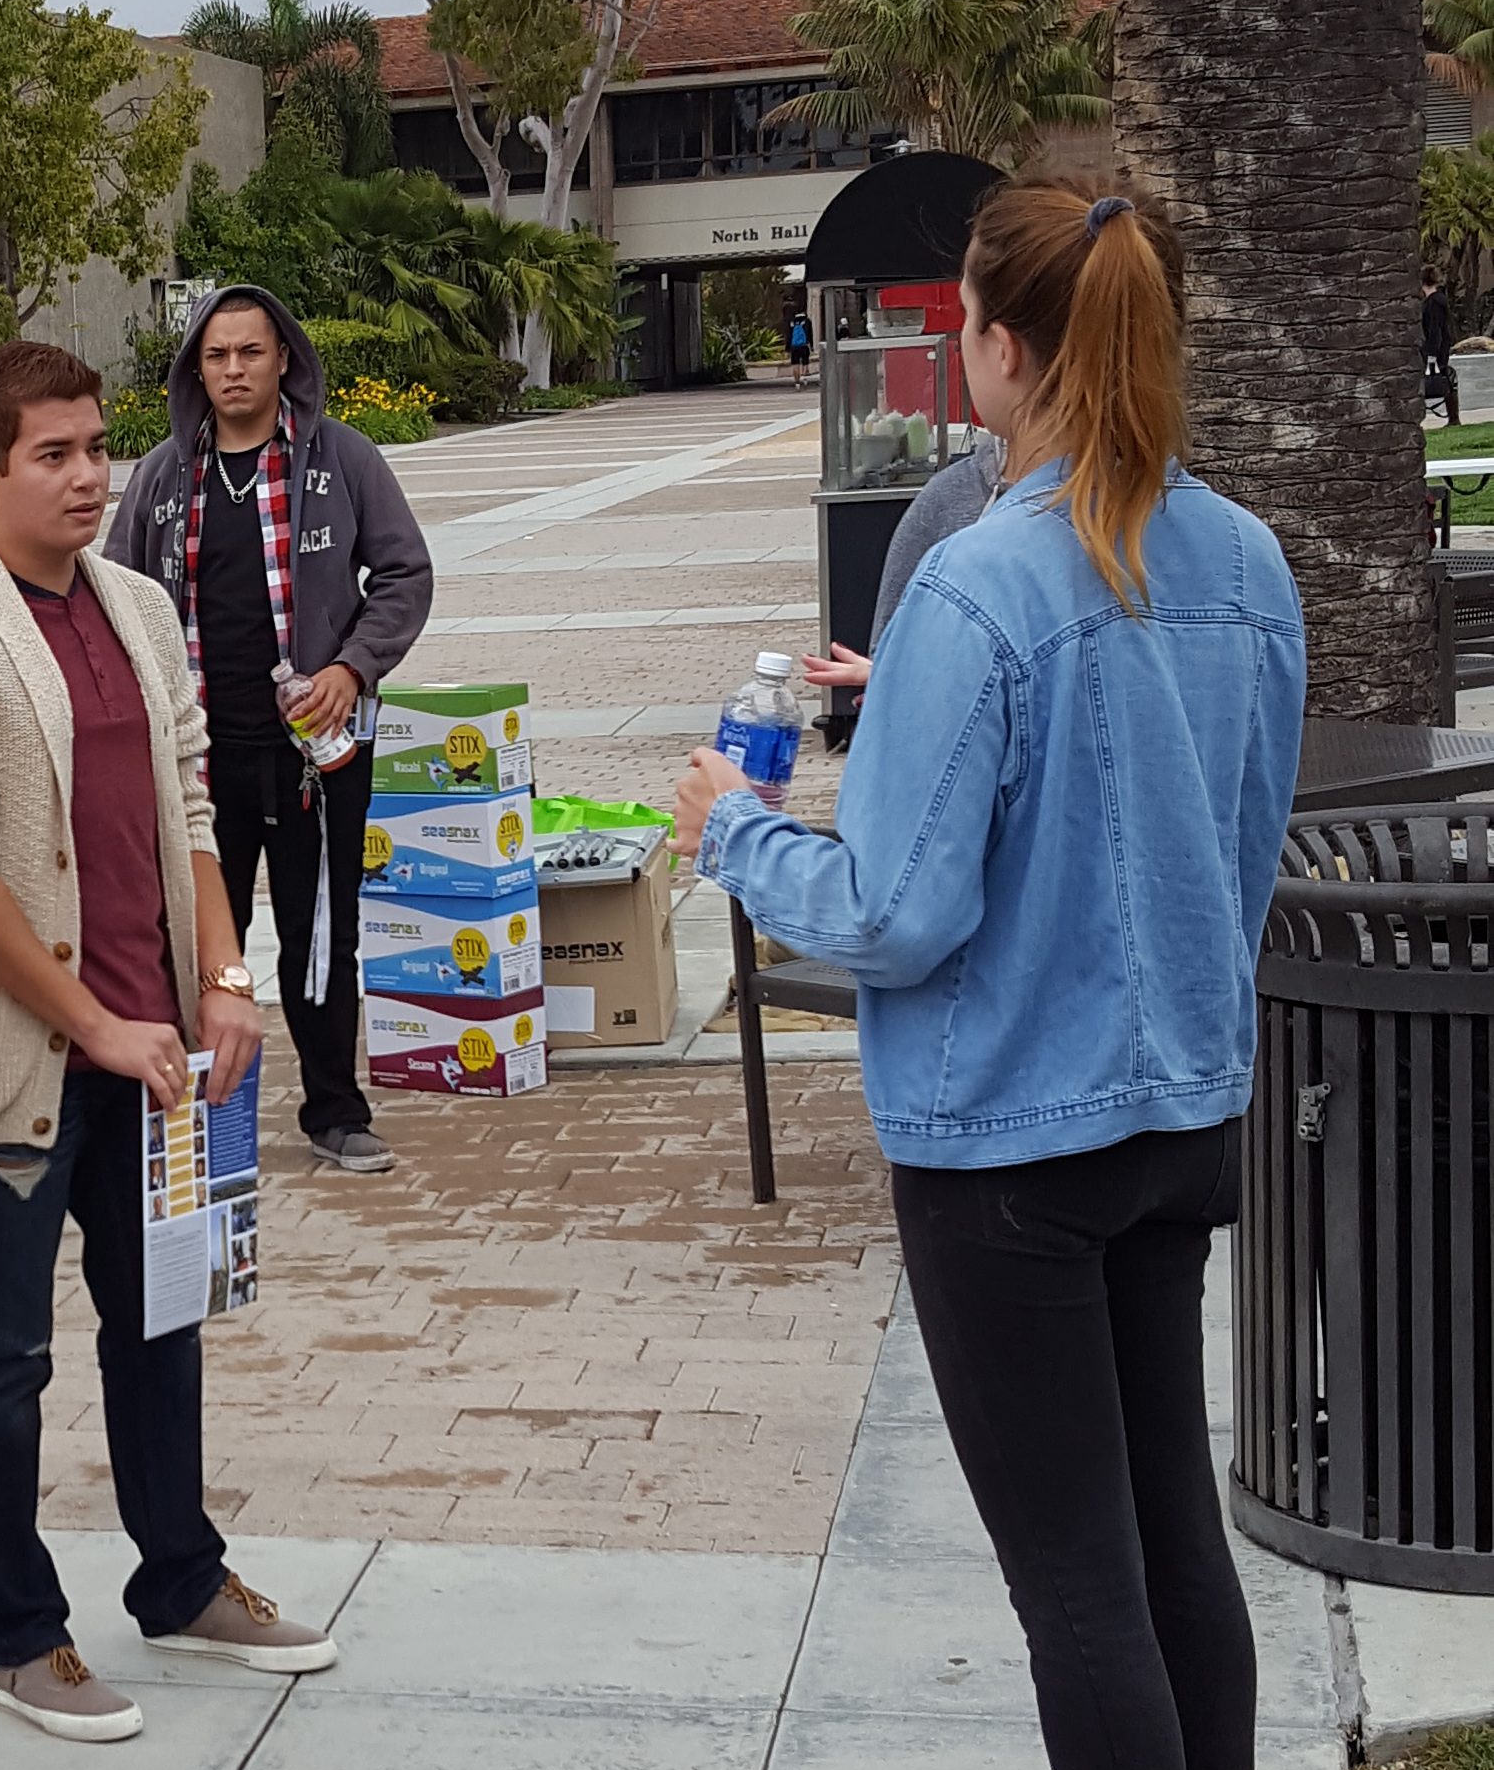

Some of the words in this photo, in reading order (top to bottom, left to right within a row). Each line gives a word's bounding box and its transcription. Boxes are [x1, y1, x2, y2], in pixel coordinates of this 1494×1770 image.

[712, 228, 759, 244] North
[770, 224, 808, 240] Hall
[449, 735, 482, 754] STIX
[421, 826, 481, 838] seasnax
[499, 814, 520, 835] STIX
[364, 921, 422, 935] seasnax
[456, 938, 486, 958] STIX
[371, 1019, 429, 1034] seasnax
[462, 1037, 491, 1057] STIX
